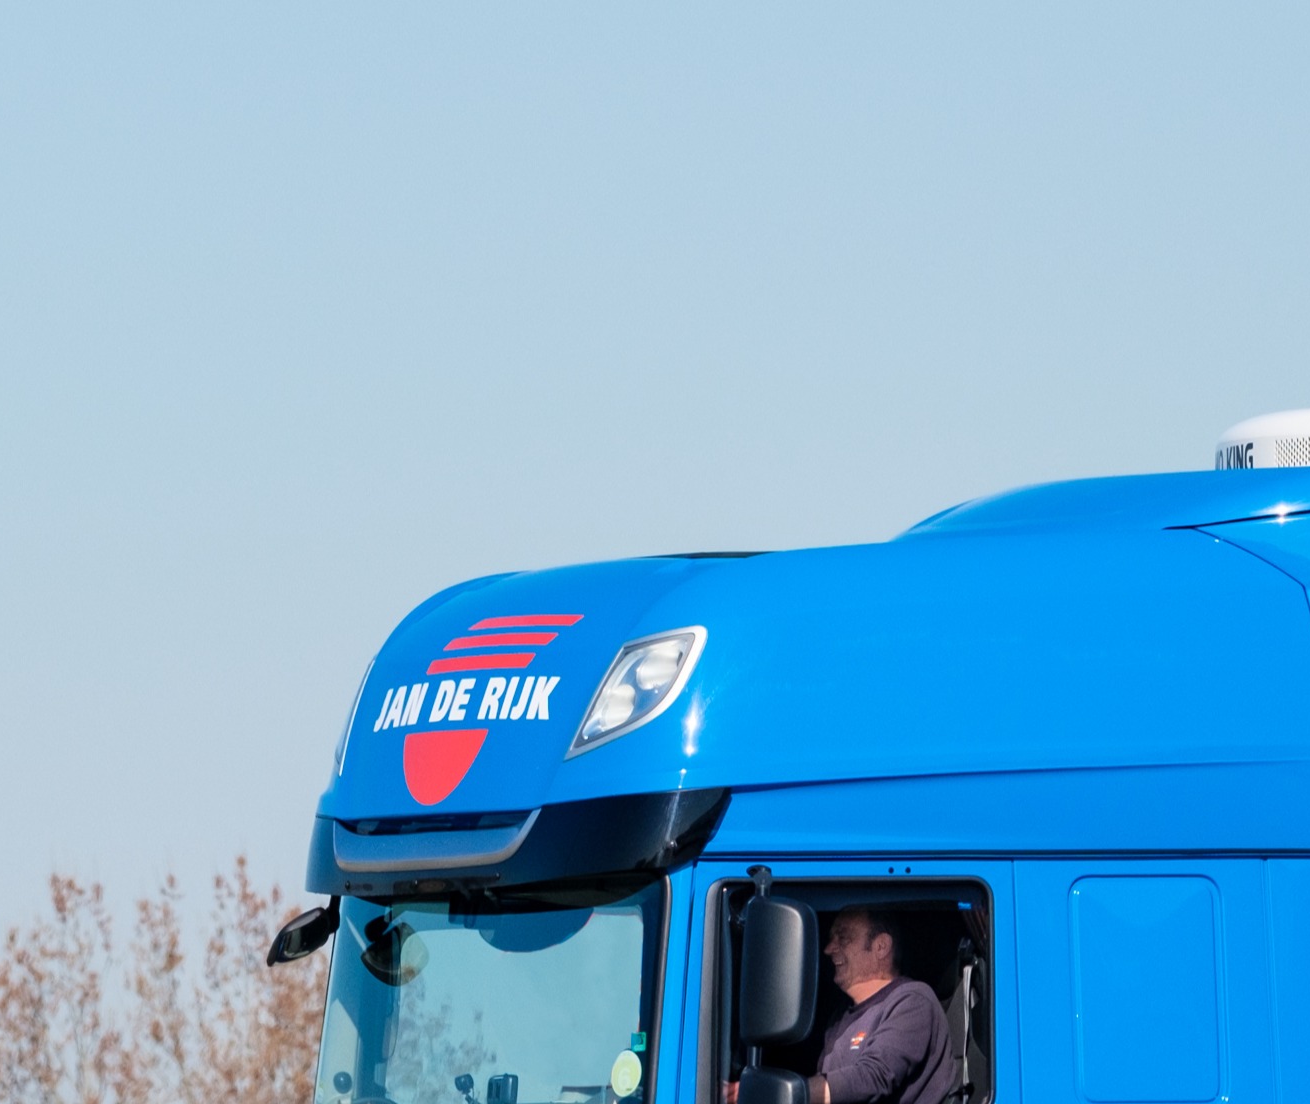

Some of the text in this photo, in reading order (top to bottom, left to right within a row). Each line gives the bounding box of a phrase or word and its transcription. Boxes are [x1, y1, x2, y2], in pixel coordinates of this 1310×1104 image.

[1226, 442, 1254, 469] KING
[373, 676, 561, 732] JAN DE RIJK
